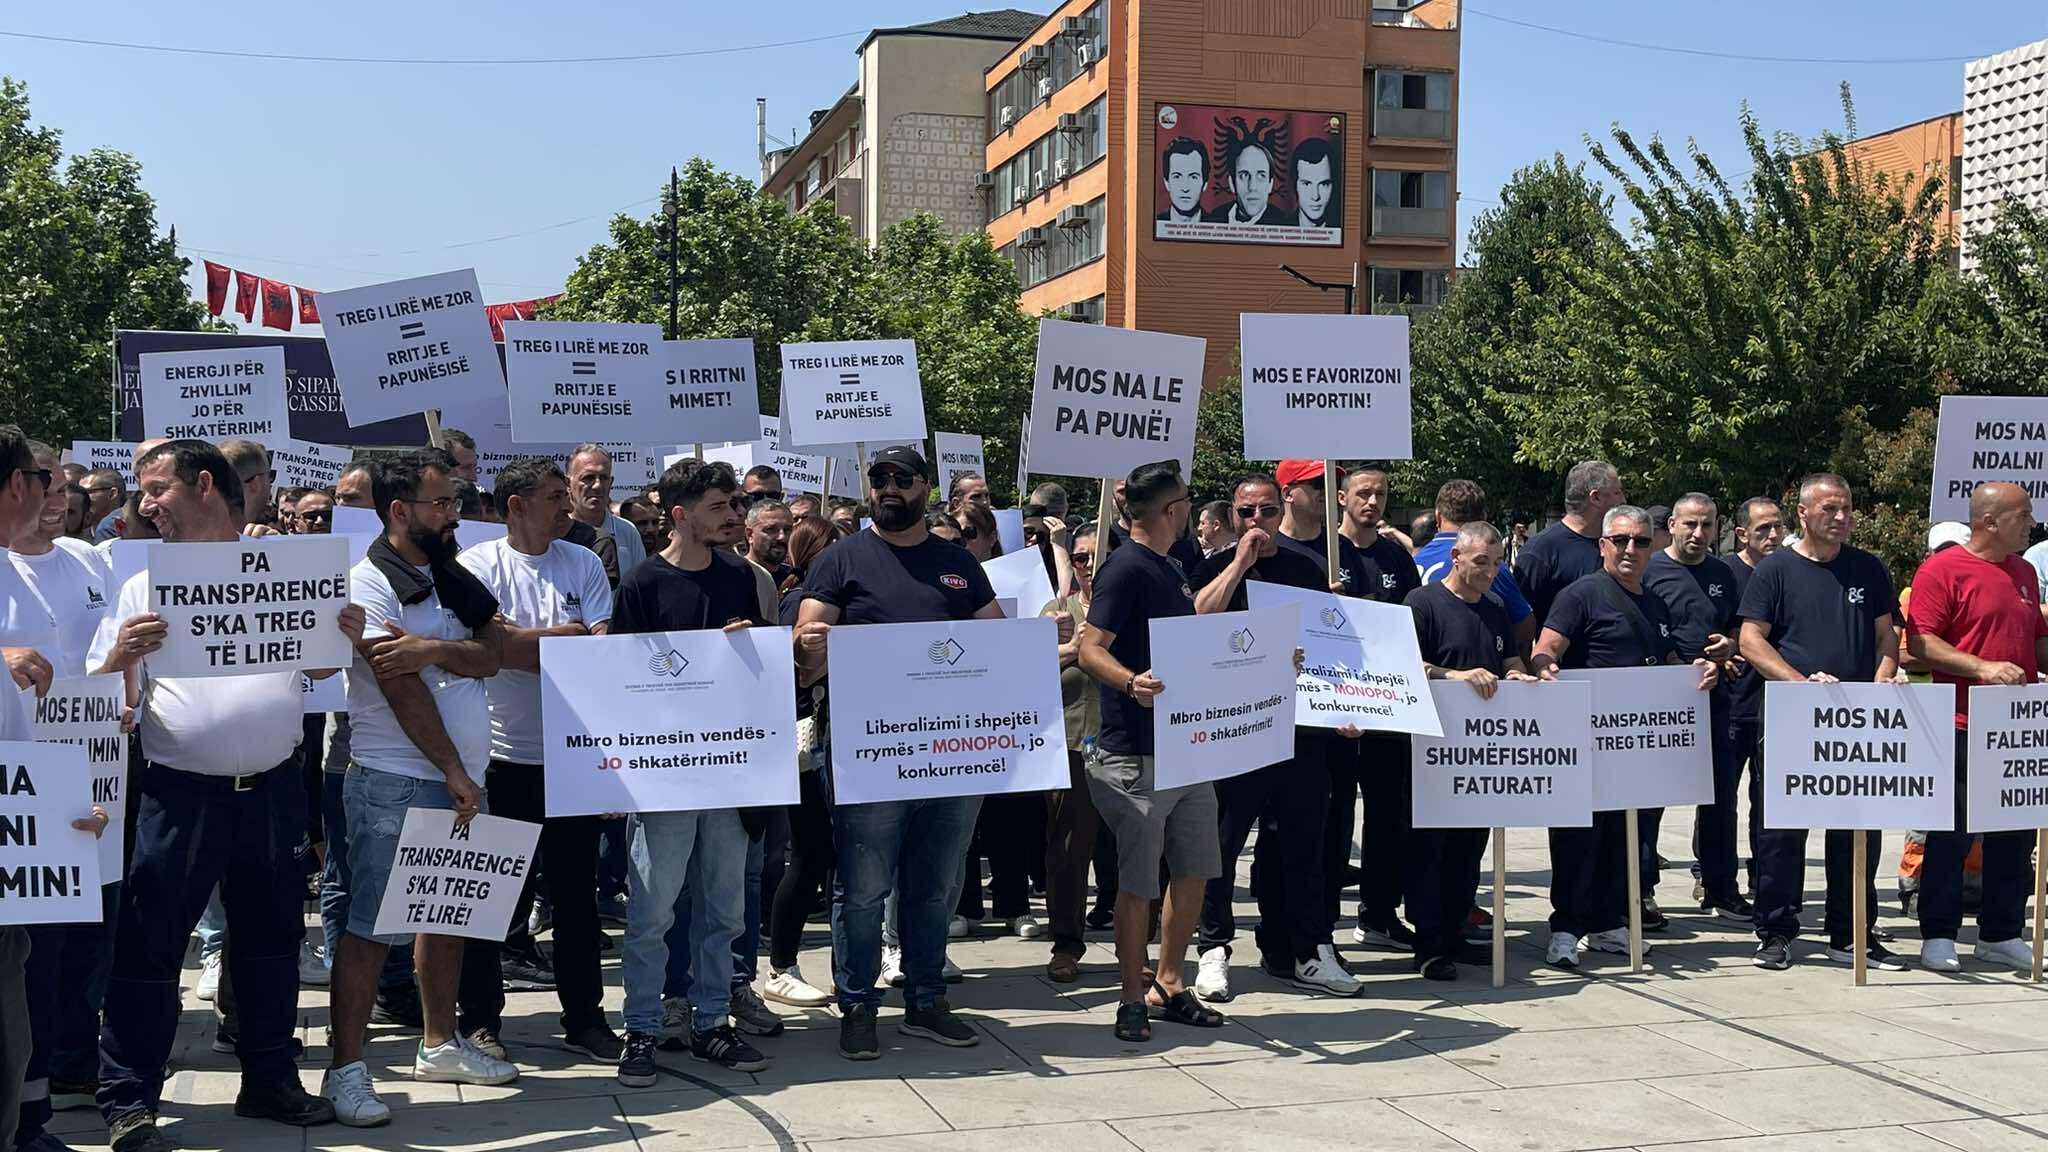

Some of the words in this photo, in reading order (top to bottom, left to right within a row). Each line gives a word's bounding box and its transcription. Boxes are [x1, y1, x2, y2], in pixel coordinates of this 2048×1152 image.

[336, 308, 376, 326] TREG
[378, 306, 384, 319] I
[386, 296, 420, 318] LIRË
[422, 295, 444, 310] ME
[445, 290, 474, 306] ZOR
[387, 344, 439, 366] RRITJE
[440, 342, 450, 355] E
[513, 340, 552, 353] TREG
[555, 342, 560, 353] I
[564, 338, 595, 354] LIRË
[598, 342, 619, 354] ME
[622, 342, 649, 355] ZOR
[165, 365, 230, 380] ENERGJI
[235, 360, 264, 376] PËR
[790, 358, 822, 370] TREG
[825, 357, 829, 368] I
[832, 354, 858, 368] LIRË
[861, 356, 879, 366] ME
[881, 355, 904, 366] ZOR
[378, 356, 470, 390] PAPUNËSISË
[681, 369, 686, 384] I
[690, 367, 746, 384] RRITNI
[1252, 368, 1288, 383] MOS
[1292, 368, 1302, 383] E
[1306, 367, 1401, 384] FAVORIZONI
[180, 383, 252, 399] ZHVILLIM
[555, 384, 604, 396] RRITJE
[608, 384, 616, 396] E
[1052, 364, 1106, 395] MOS
[1112, 371, 1146, 400] NA
[1154, 375, 1183, 403] LE
[289, 394, 343, 412] CASSE
[670, 392, 732, 409] MIMET!
[826, 391, 868, 404] RRITJE
[870, 390, 878, 401] E
[1286, 392, 1371, 408] IMPORTIN!
[192, 404, 210, 418] JO
[214, 401, 244, 416] PËR
[542, 400, 632, 416] PAPUNËSISË
[815, 403, 892, 421] PAPUNËSISË
[165, 421, 272, 439] SHKATËRRIM!
[1055, 406, 1089, 434] PA
[1096, 409, 1171, 442] PUNË!
[1976, 422, 2016, 440] MOS
[2020, 422, 2047, 440] NA
[91, 448, 114, 457] MOS
[116, 448, 132, 458] NA
[308, 446, 320, 455] PA
[773, 455, 786, 465] JO
[788, 456, 807, 469] PËR
[1972, 451, 2043, 470] NDALNI
[310, 470, 334, 480] TREG
[241, 552, 271, 572] PA
[156, 574, 346, 606] TRANSPARENCË
[256, 610, 316, 633] TREG
[206, 641, 236, 666] TË
[245, 637, 302, 664] LIRË!
[1362, 670, 1405, 687] shpejtë
[1309, 698, 1394, 716] konkurrencë!
[1406, 692, 1418, 705] jo
[36, 698, 67, 724] MOS
[71, 697, 80, 723] E
[1170, 710, 1201, 725] Mbro
[1205, 704, 1252, 720] biznesin
[1254, 695, 1282, 712] vendës
[1814, 707, 1866, 729] MOS
[1874, 708, 1908, 729] NA
[866, 714, 961, 735] Liberalizimi
[965, 714, 970, 729] i
[974, 711, 1029, 731] shpejtë
[1034, 711, 1038, 725] i
[1190, 731, 1207, 744] JO
[1210, 718, 1273, 741] shkatërrimit!
[1465, 718, 1508, 737] MOS
[1513, 719, 1541, 737] NA
[566, 735, 613, 748] Mbro
[618, 730, 695, 746] biznesin
[700, 726, 766, 742] vendës
[1595, 735, 1634, 751] TREG
[1637, 730, 1655, 749] TË
[1659, 729, 1695, 748] LIRË!
[1986, 729, 2048, 750] FALEN
[855, 740, 914, 762] rrymës
[932, 735, 1025, 754] MONOPOL,
[1029, 732, 1045, 751] jo
[1426, 742, 1577, 766] SHUMËFISHONI
[1814, 741, 1906, 763] NDALNI
[597, 758, 622, 770] JO
[628, 751, 748, 770] shkatërrimit!
[898, 757, 1006, 779] konkurrencë!
[1453, 777, 1552, 795] FATURAT!
[1785, 775, 1934, 797] PRODHIMIN!
[2000, 788, 2048, 807] NDIH
[450, 822, 470, 840] PA
[399, 847, 526, 877] TRANSPARENCË
[444, 877, 490, 900] TREG
[406, 900, 425, 922] TË
[426, 902, 472, 926] LIRË!
